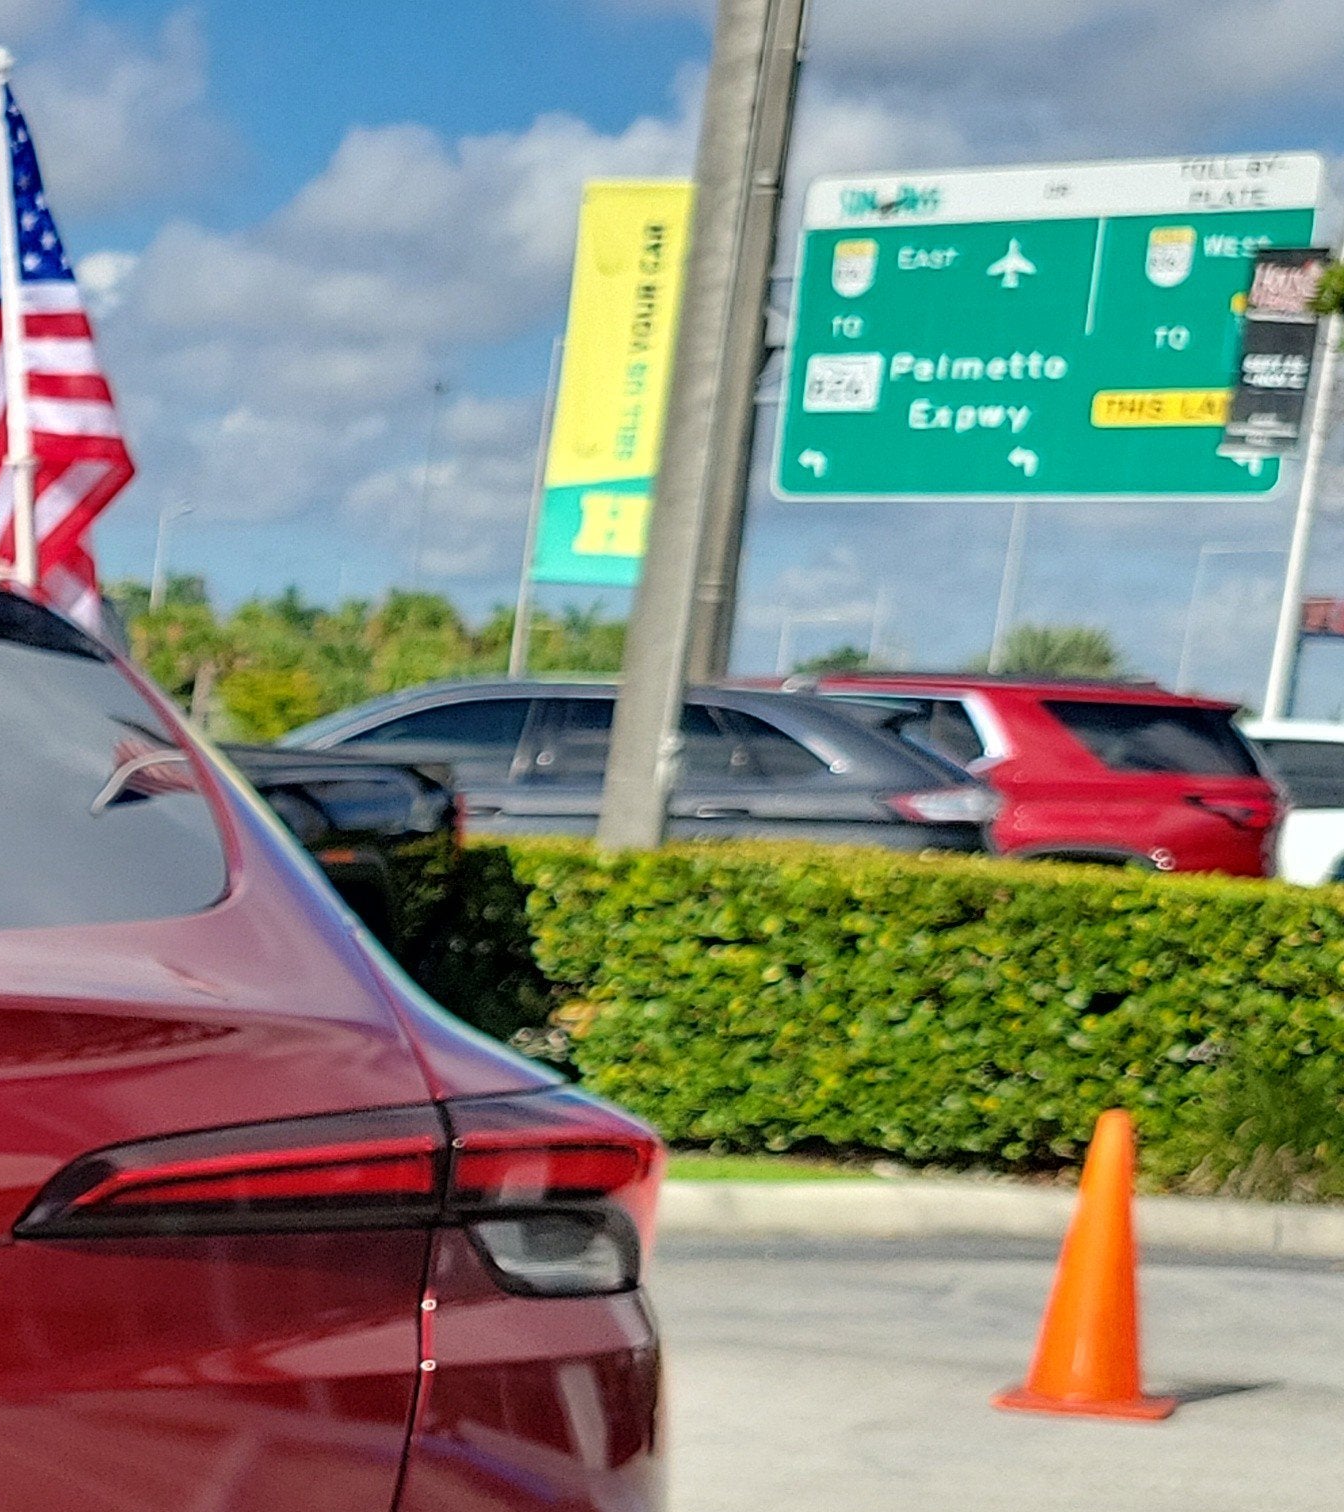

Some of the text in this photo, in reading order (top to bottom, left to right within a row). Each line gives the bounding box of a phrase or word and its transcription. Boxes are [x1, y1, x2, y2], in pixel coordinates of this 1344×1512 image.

[896, 245, 960, 270] EAST
[832, 314, 863, 339] TO
[1154, 325, 1190, 351] TO
[889, 351, 1069, 382] Palmetto
[908, 398, 1032, 434] Expwy
[1105, 397, 1229, 420] THIS LA
